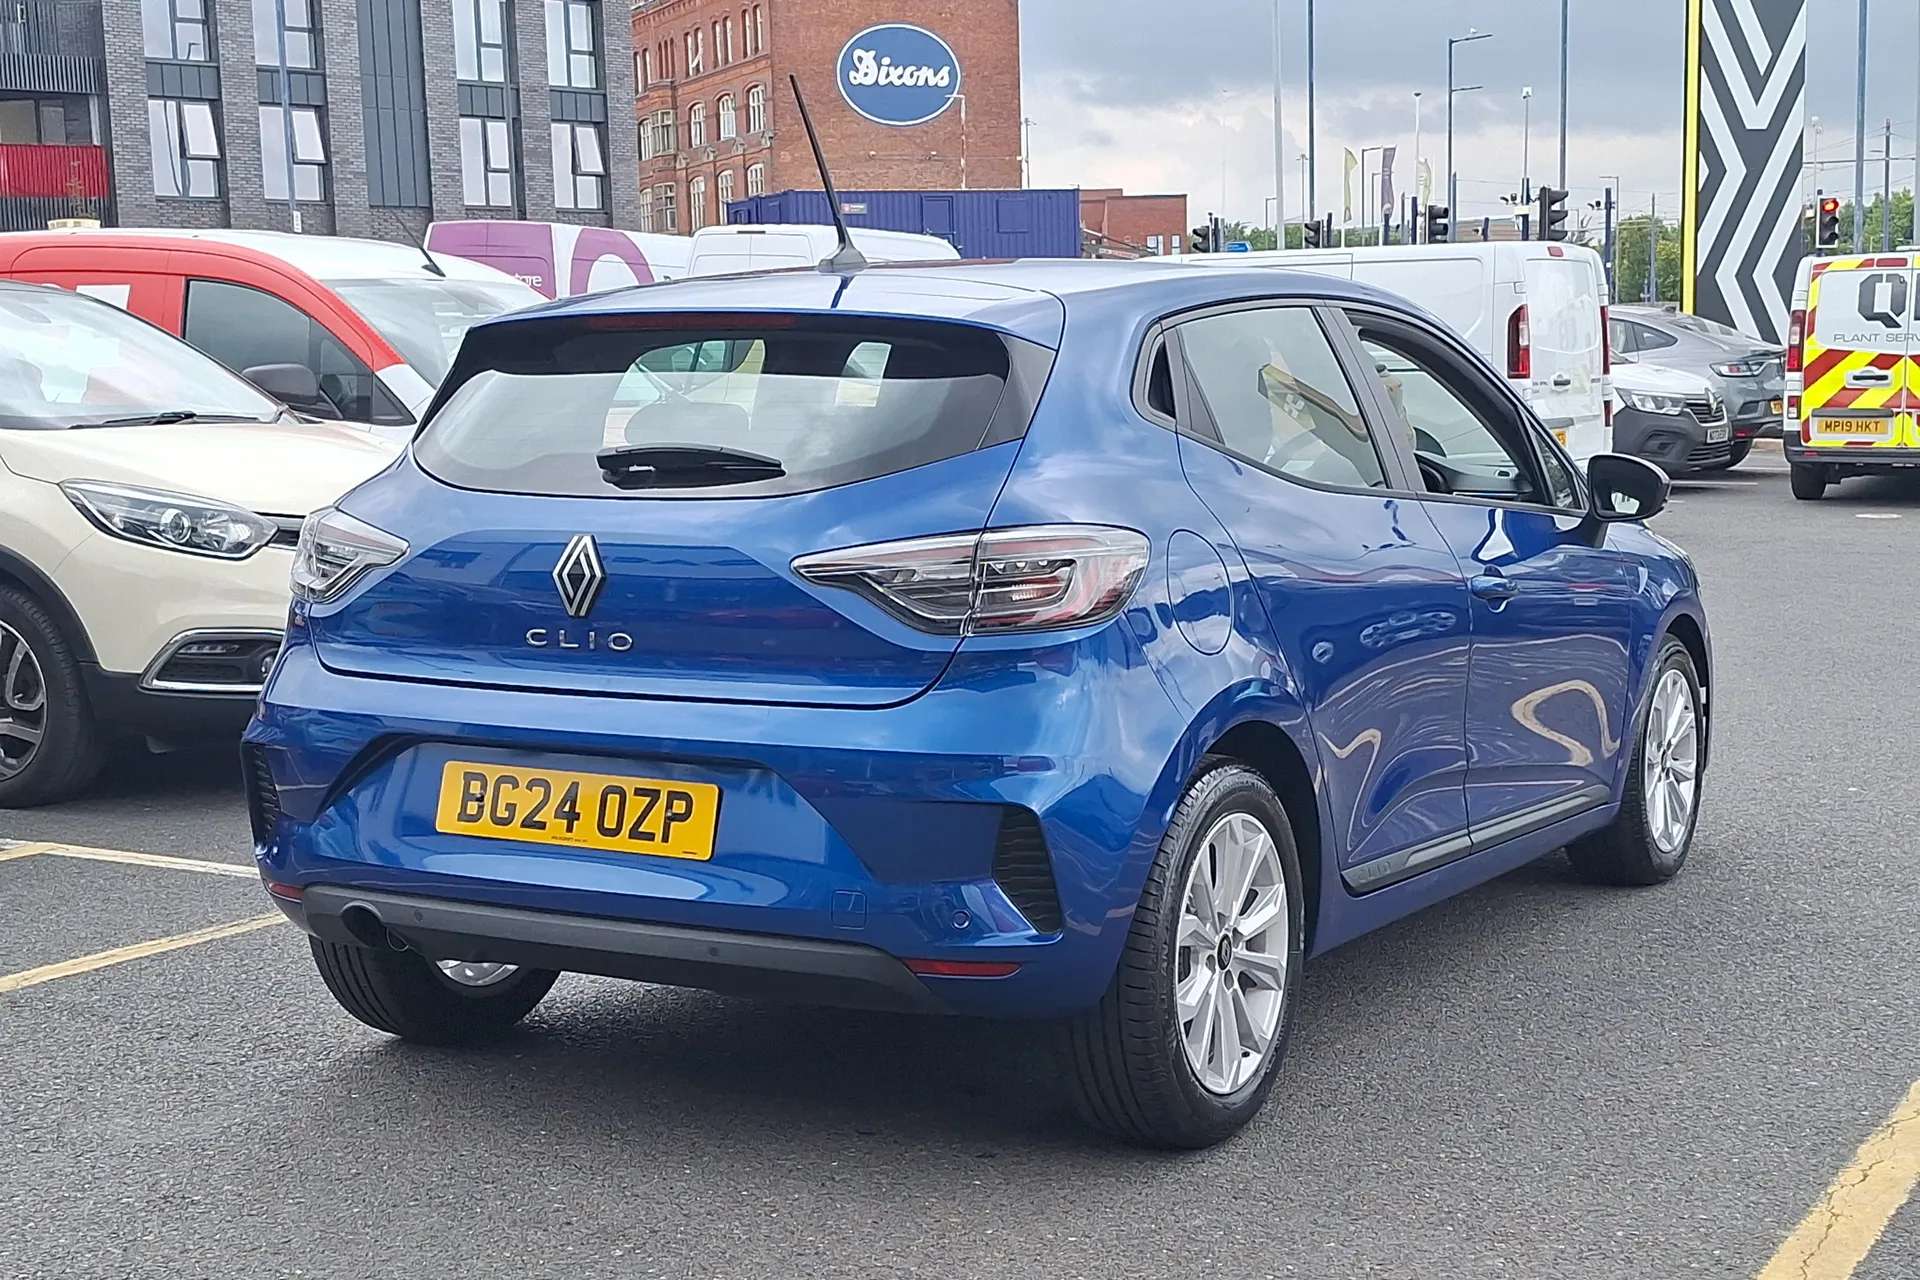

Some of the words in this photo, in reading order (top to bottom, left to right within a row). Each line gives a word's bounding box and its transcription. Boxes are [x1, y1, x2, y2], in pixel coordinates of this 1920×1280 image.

[849, 48, 950, 88] Dixons
[1833, 333, 1880, 343] PLANT
[1824, 420, 1852, 432] MP19
[1855, 420, 1880, 432] HKT
[526, 628, 633, 651] CLIO
[457, 771, 580, 834] BG24
[596, 784, 694, 844] OZP
